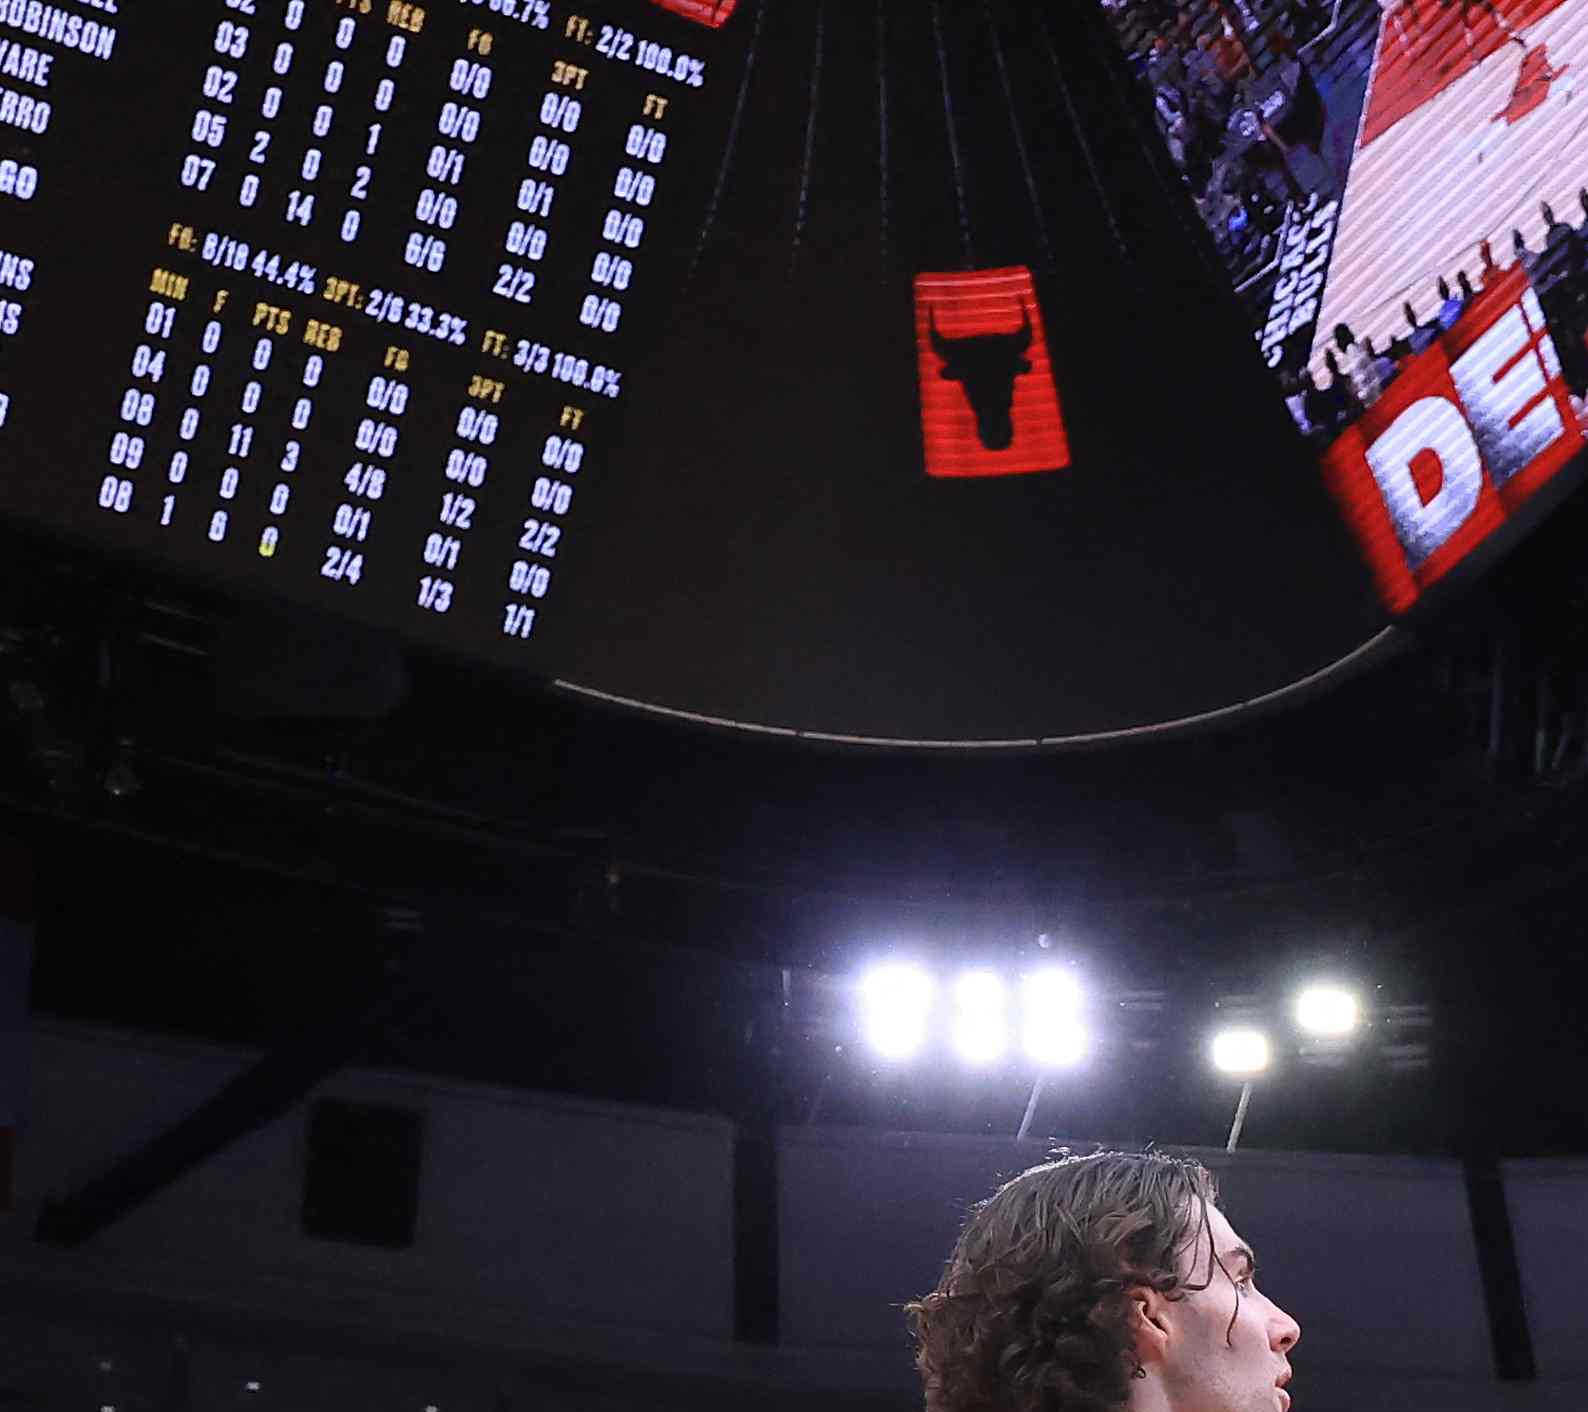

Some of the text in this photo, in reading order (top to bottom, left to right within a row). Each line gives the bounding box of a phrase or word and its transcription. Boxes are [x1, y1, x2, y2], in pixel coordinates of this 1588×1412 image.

[215, 21, 248, 58] 03
[273, 43, 293, 74] 0
[324, 61, 344, 93] 0
[375, 79, 394, 111] 0
[614, 167, 655, 206] 0/0
[336, 17, 355, 49] 0
[386, 36, 406, 67] 0
[450, 59, 491, 99] 0/0
[540, 93, 581, 132] 0/0
[626, 125, 666, 163] 0/0
[552, 61, 588, 89] 3PT
[643, 95, 667, 119] FT
[596, 25, 635, 62] 2/2
[635, 40, 705, 88] 100.0%
[192, 110, 227, 147] 05
[249, 131, 270, 163] 2
[302, 149, 322, 180] 0
[351, 166, 371, 199] 2
[506, 222, 547, 260] 0/0
[591, 252, 632, 290] 0/0
[203, 66, 238, 103] 02
[262, 87, 282, 118] 0
[313, 106, 333, 136] 0
[367, 124, 381, 154] 1
[427, 146, 464, 184] 0/1
[517, 179, 554, 217] 0/1
[603, 210, 643, 248] 0/0
[181, 155, 621, 332] 07 0 14 0 6/6 2/2 0/0
[251, 250, 317, 295] 44.4%
[404, 302, 468, 346] 33.3%
[481, 330, 509, 359] FT:
[513, 339, 551, 374] 3/3
[132, 345, 572, 514] 04 0 0 0 0/0 0/0 0/0
[145, 302, 583, 473] 01 0 0 0 0/0 0/0 0/0
[253, 303, 291, 334] PTS
[469, 376, 504, 402] 3PT
[560, 407, 583, 429] FT
[110, 432, 550, 597] 09 0 0 0 0/1 0/1 0/0
[121, 388, 560, 557] 08 0 11 3 4/8 1/2 2/2
[99, 476, 133, 512] 08
[161, 495, 175, 525] 1
[321, 546, 363, 584] 2/4
[418, 576, 453, 612] 1/3
[504, 604, 535, 638] 1/1
